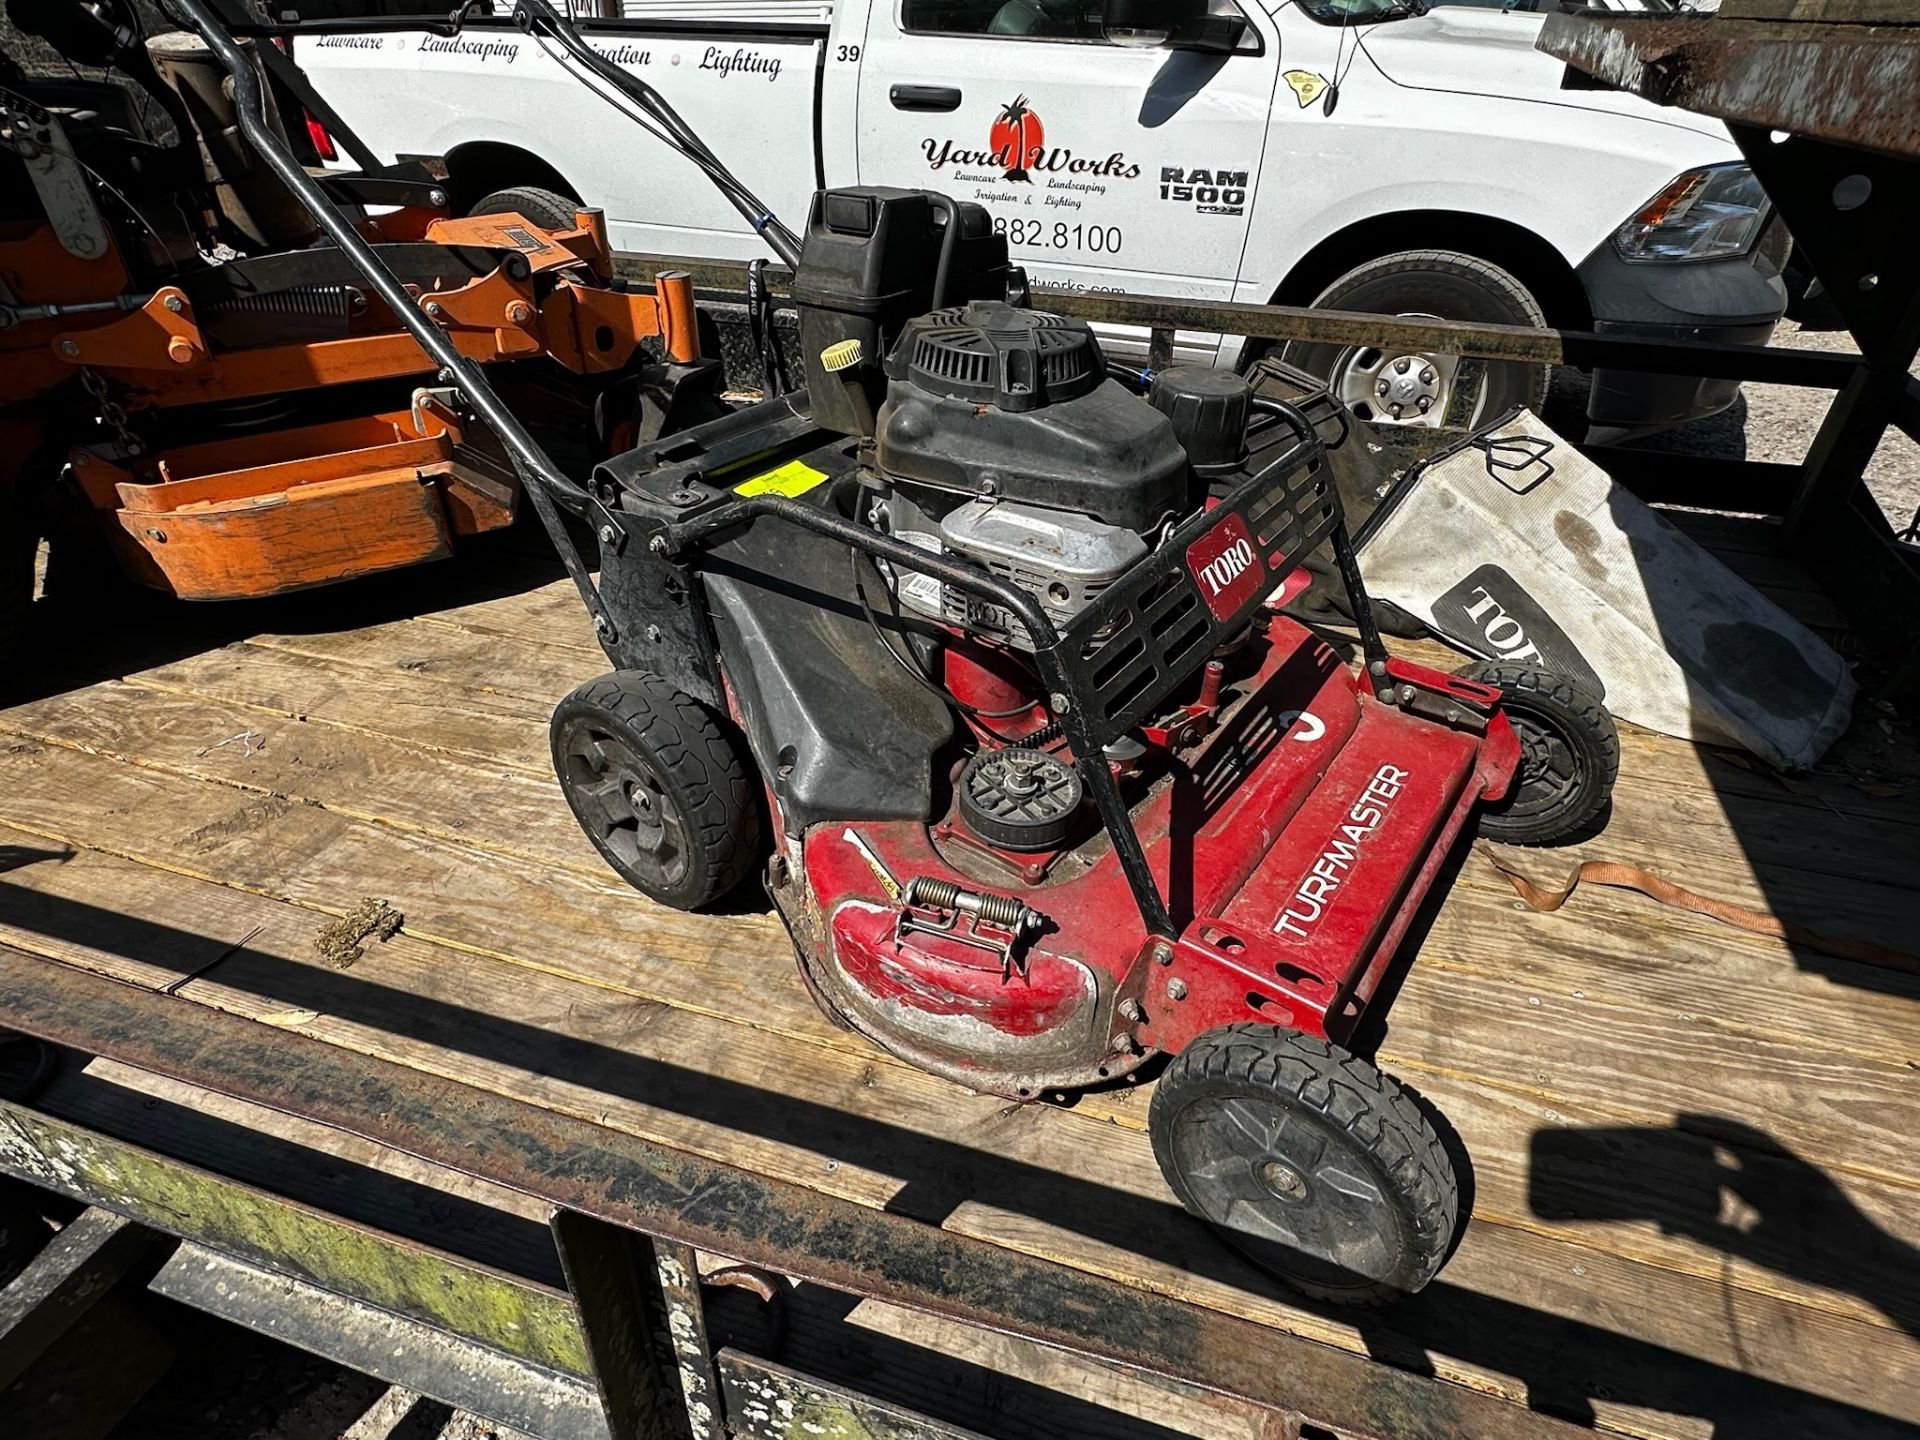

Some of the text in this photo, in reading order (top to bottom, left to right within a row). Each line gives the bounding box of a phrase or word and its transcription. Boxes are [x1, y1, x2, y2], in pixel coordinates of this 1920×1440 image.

[316, 35, 384, 50] Lawncare
[417, 33, 520, 64] Landscaping
[698, 46, 783, 82] Lighting
[836, 45, 860, 63] 39
[920, 138, 1141, 179] Yard Works
[953, 170, 1106, 194] Lawncare Landscaping
[1160, 166, 1249, 188] RAM
[973, 188, 1082, 210] Irrigation & Lighting
[1160, 184, 1246, 205] 1500
[993, 216, 1122, 254] 882.8100
[1028, 275, 1126, 294] dworkscom
[1200, 538, 1253, 597] TORO
[1273, 764, 1409, 938] TURFMASTER
